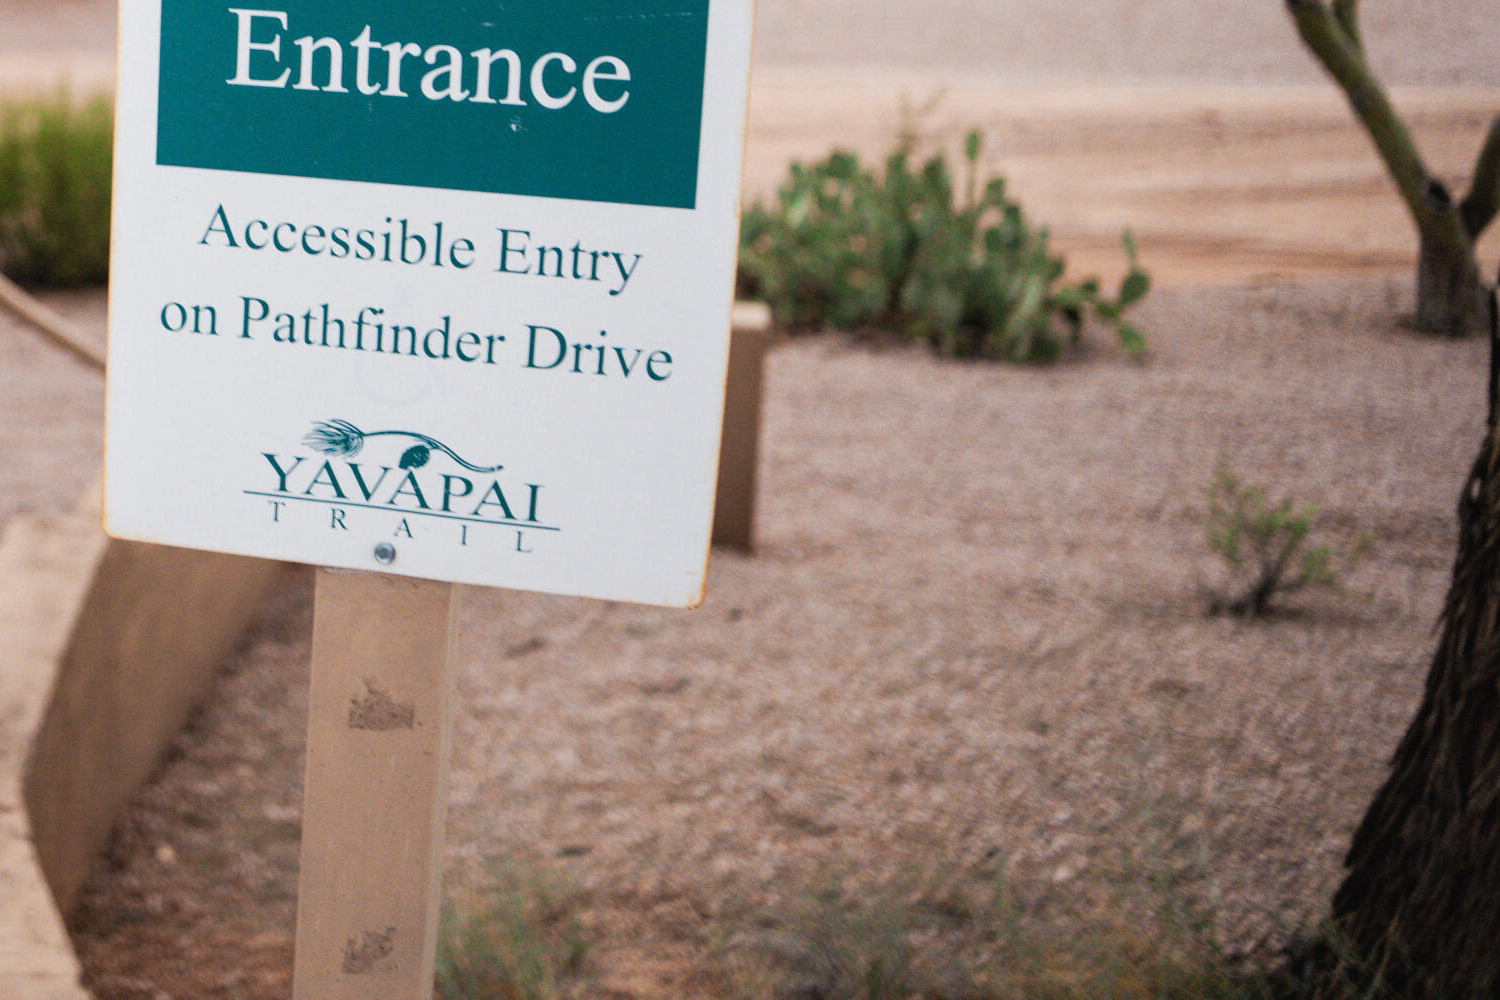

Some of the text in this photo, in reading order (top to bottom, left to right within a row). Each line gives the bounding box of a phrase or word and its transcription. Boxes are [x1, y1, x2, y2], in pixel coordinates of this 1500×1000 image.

[225, 8, 631, 113] Entrance
[198, 203, 644, 297] Accessible Entry
[159, 296, 674, 382] on Pathfinder Drive
[261, 451, 546, 523] YAVAPAI
[267, 500, 533, 554] TRAIL
